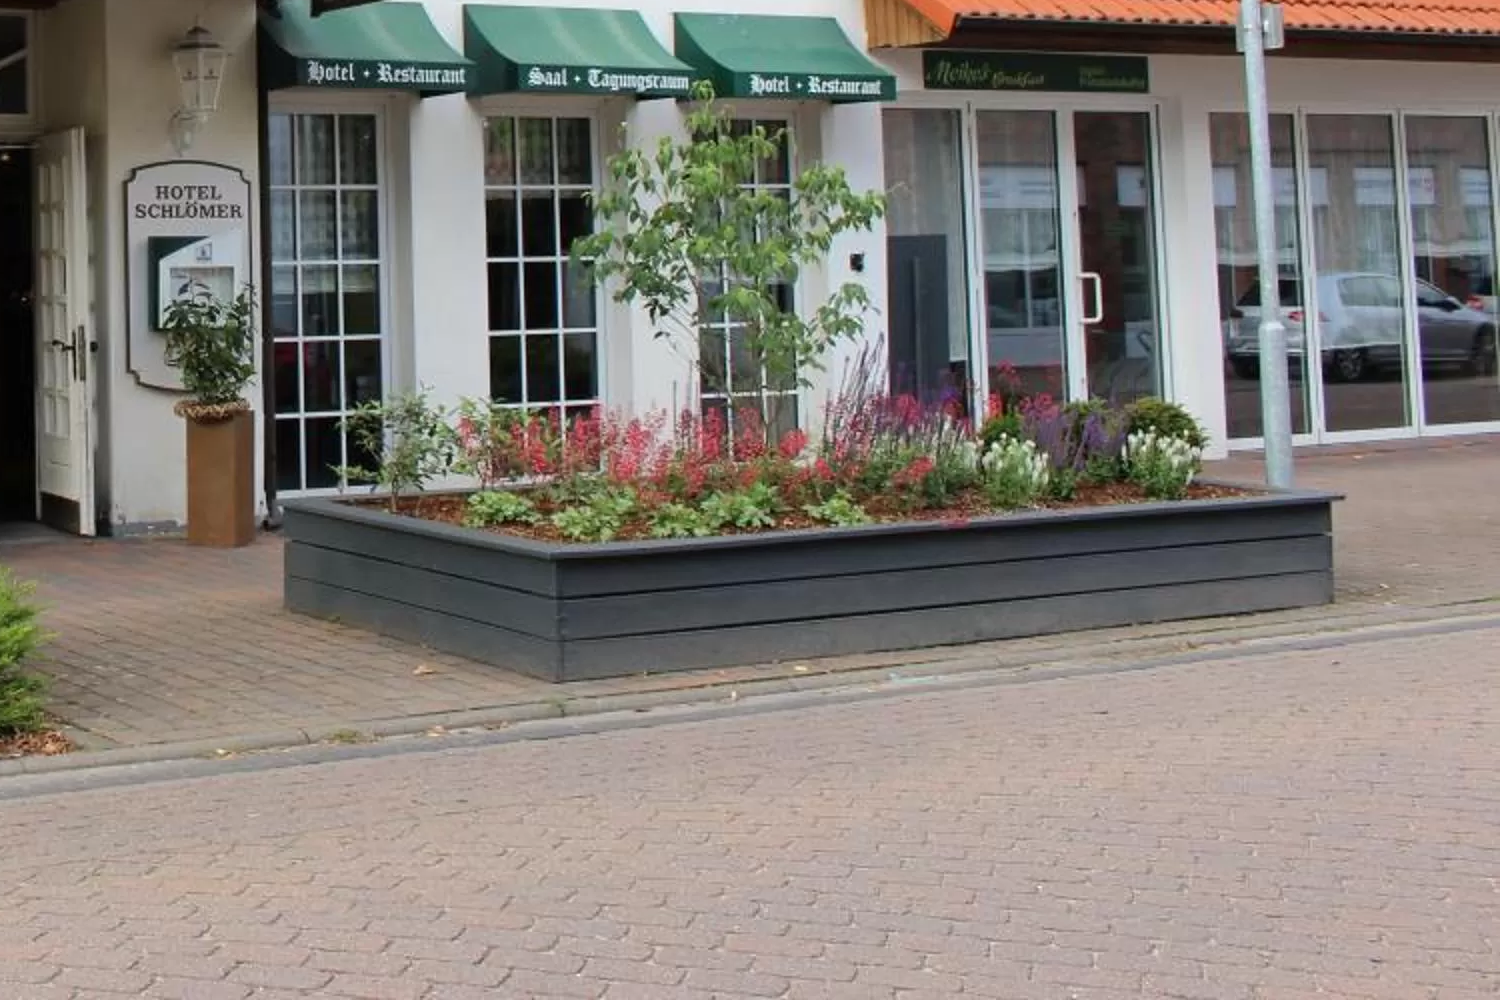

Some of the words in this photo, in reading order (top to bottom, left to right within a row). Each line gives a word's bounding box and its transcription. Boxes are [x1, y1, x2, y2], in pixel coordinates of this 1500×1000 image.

[307, 60, 355, 84] Hotel
[376, 62, 467, 85] Restaurant
[527, 66, 568, 87] Saal
[587, 68, 690, 93] Tagungsraum
[750, 74, 790, 96] Hotel
[807, 75, 882, 95] Restaurant
[155, 184, 223, 200] HOTEL
[135, 201, 243, 219] SCHLÖMER
